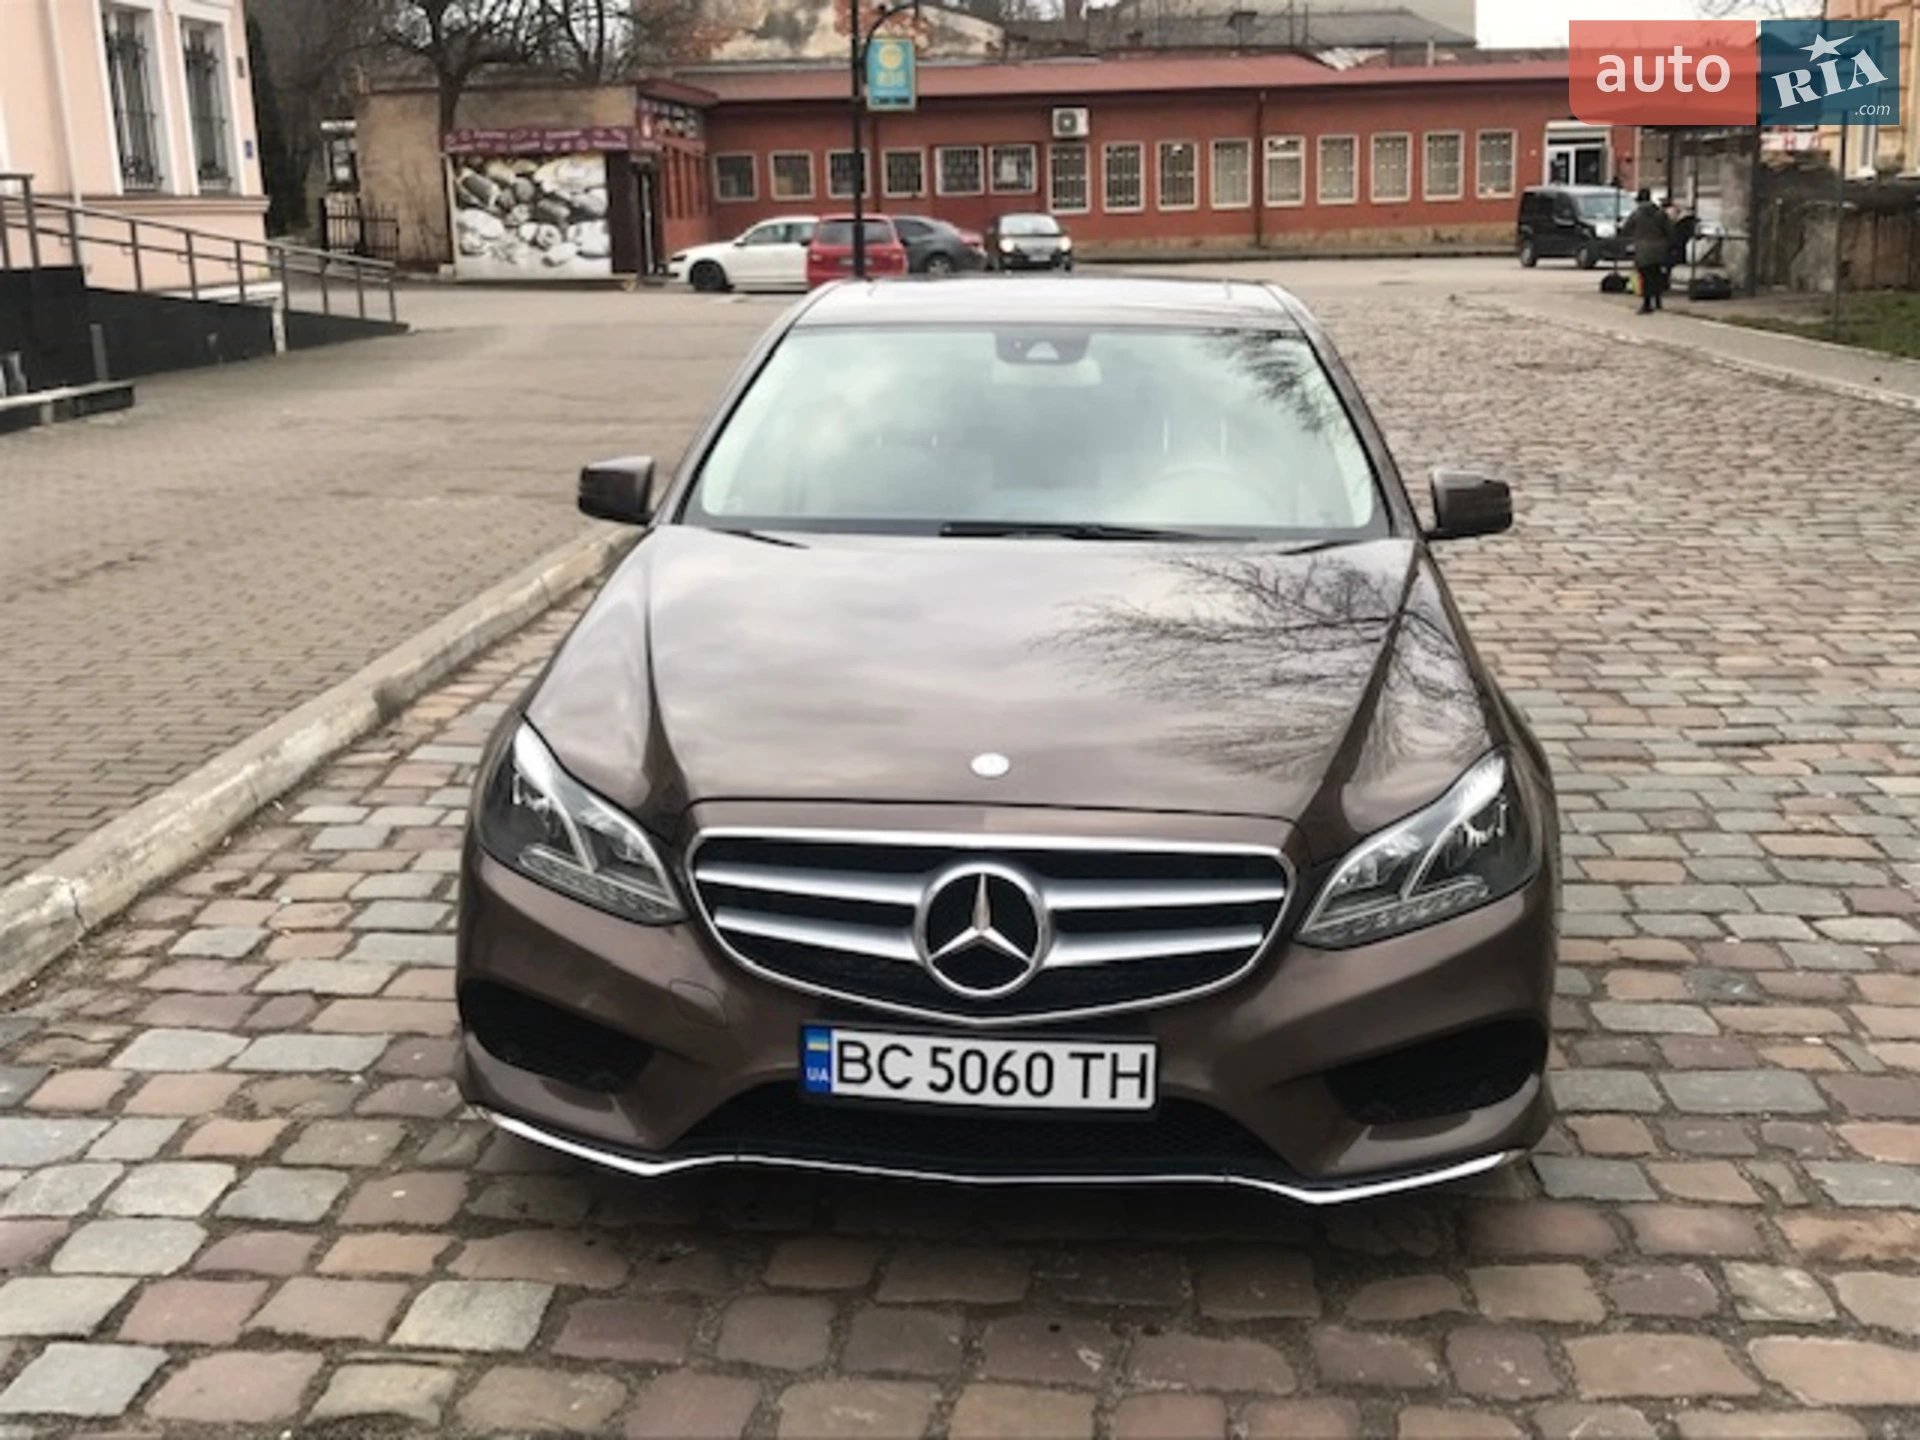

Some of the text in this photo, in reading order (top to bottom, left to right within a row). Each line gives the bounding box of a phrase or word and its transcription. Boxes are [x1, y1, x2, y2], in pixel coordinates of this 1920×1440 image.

[806, 1068, 831, 1083] UA
[836, 1040, 1148, 1099] BC 5060 TH
